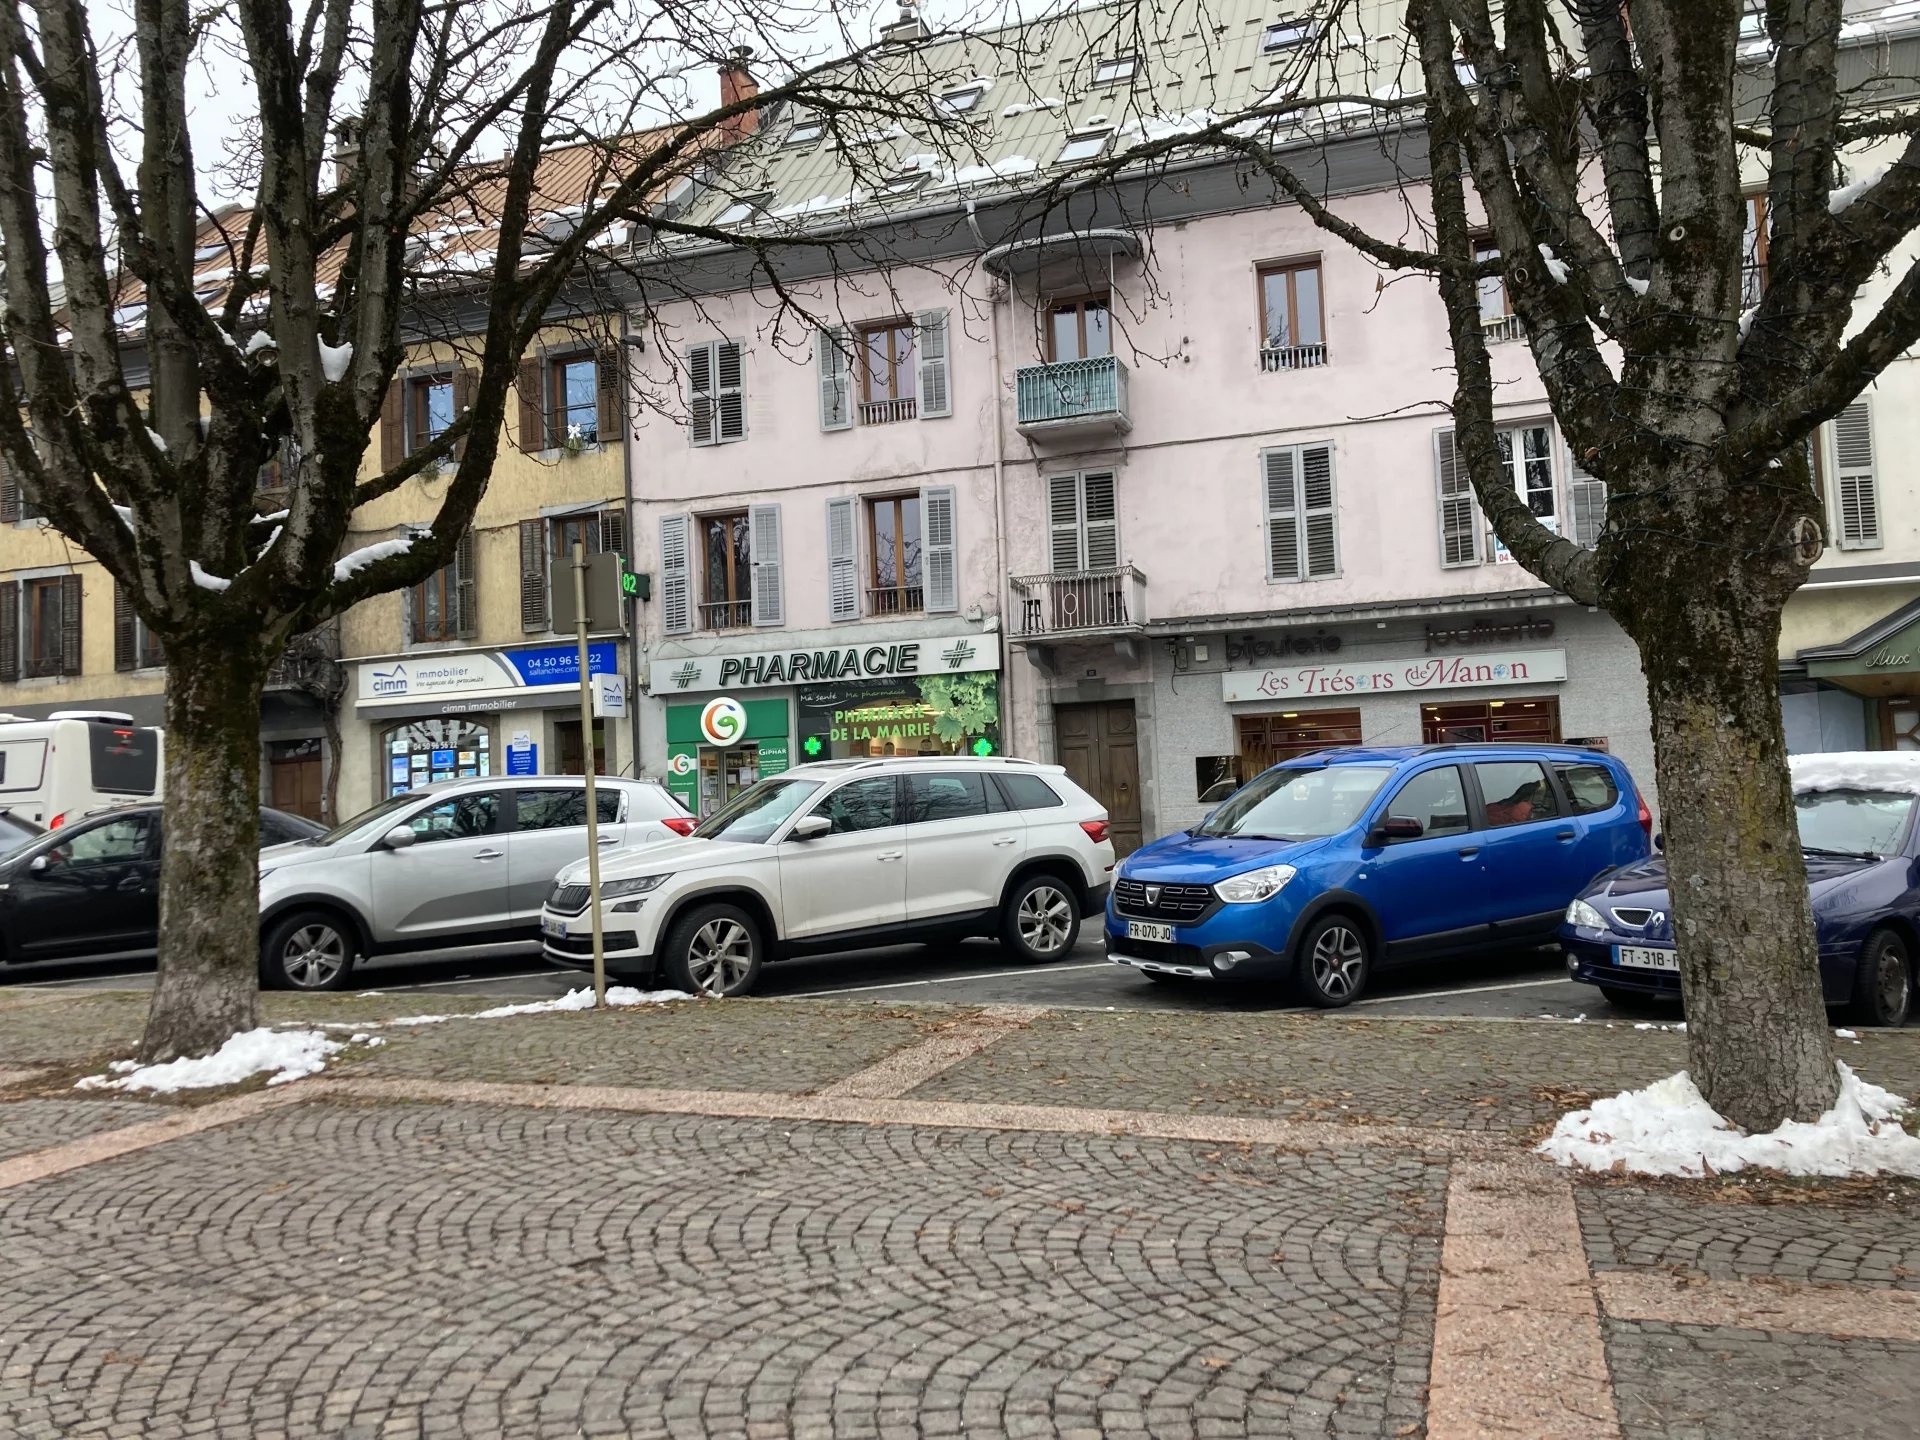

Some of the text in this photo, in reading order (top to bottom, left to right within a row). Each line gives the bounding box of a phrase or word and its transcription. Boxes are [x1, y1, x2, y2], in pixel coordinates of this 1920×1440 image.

[527, 659, 541, 668] 04
[543, 657, 557, 667] 50
[559, 656, 572, 666] 96
[589, 653, 601, 663] 22
[1866, 645, 1910, 667] Aux
[529, 664, 601, 676] sallanches.cimom
[719, 643, 920, 686] PHARMACIE
[416, 669, 469, 679] immobilier
[1257, 671, 1289, 696] Les
[1410, 666, 1427, 680] de
[373, 678, 408, 691] cimm
[603, 694, 623, 703] cimm
[441, 700, 518, 713] cimm immobilier
[835, 706, 925, 724] PHARMACIE
[830, 722, 931, 742] DE LA MAIRIE
